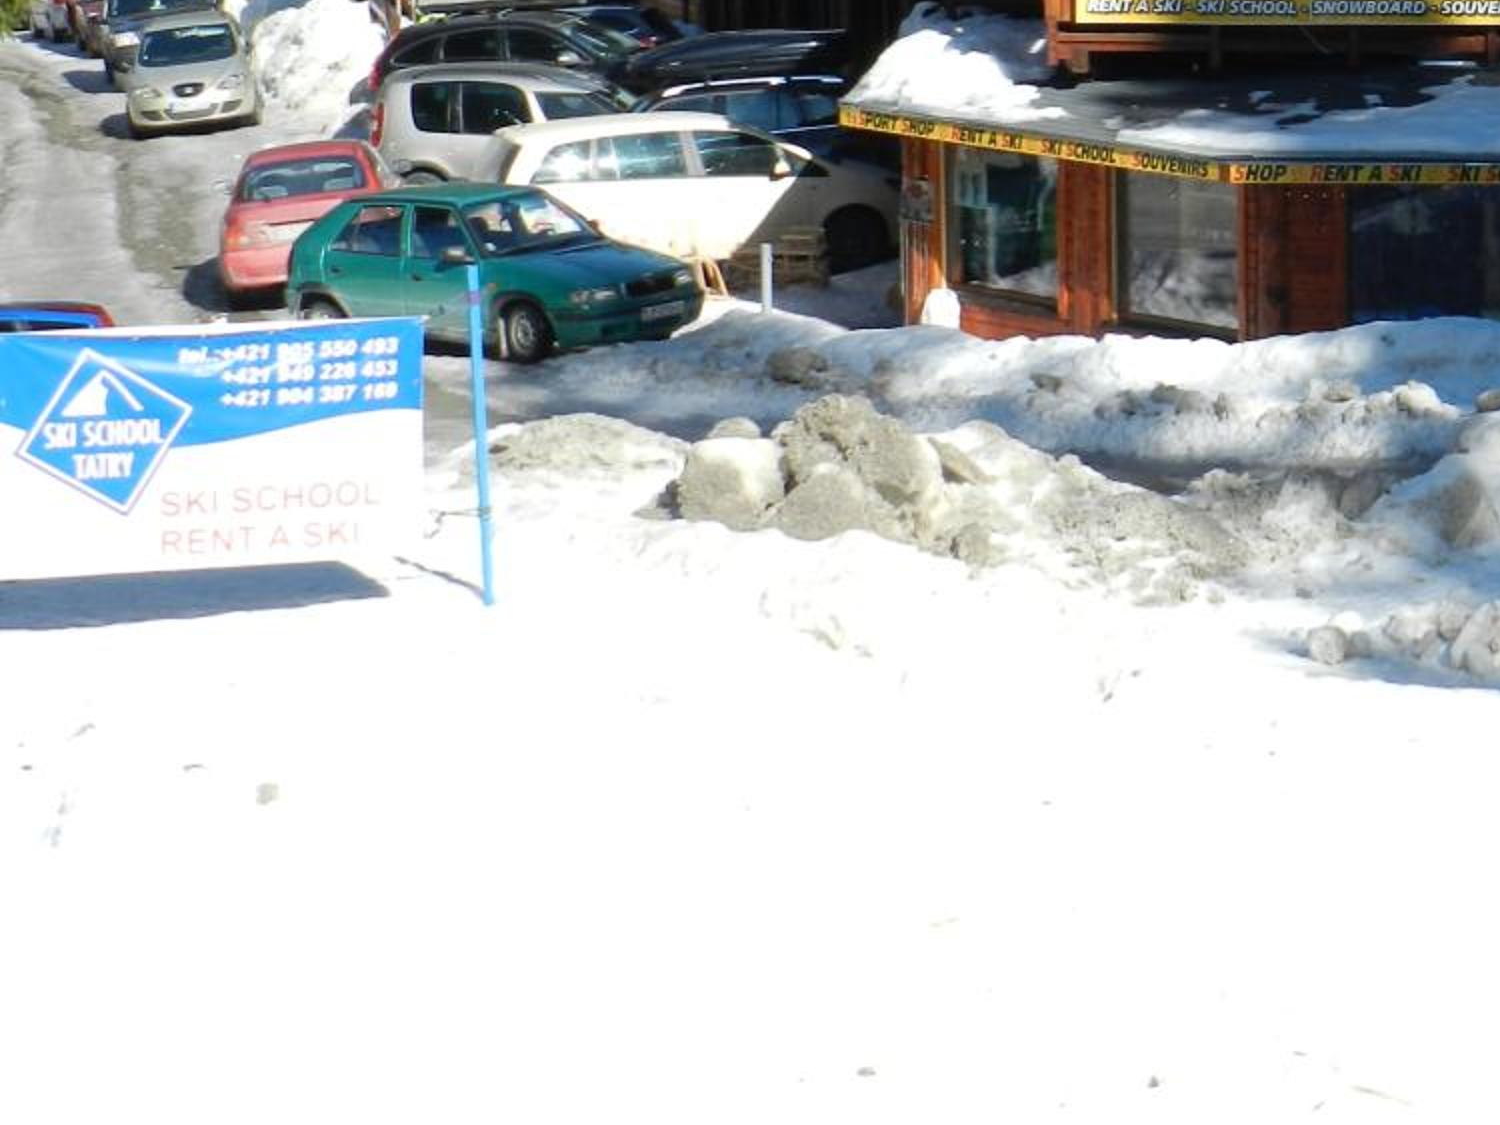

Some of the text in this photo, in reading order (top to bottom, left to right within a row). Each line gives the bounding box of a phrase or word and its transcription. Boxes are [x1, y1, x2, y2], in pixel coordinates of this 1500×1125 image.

[1311, 0, 1426, 16] SNOWBOARD
[856, 111, 1209, 177] SPORT SHOP RENT A SKI SKI SCHOOL SOUVENIRS
[1233, 164, 1287, 182] SHOP
[1310, 164, 1364, 182] RENT
[1367, 165, 1383, 182] A
[1388, 164, 1423, 182] SKI
[1447, 165, 1482, 183] SKI
[43, 418, 166, 450] SKI SCHOOL
[73, 453, 133, 479] TATRY
[161, 481, 380, 517] SKI SCHOOL
[161, 522, 360, 556] RENT A SKI
